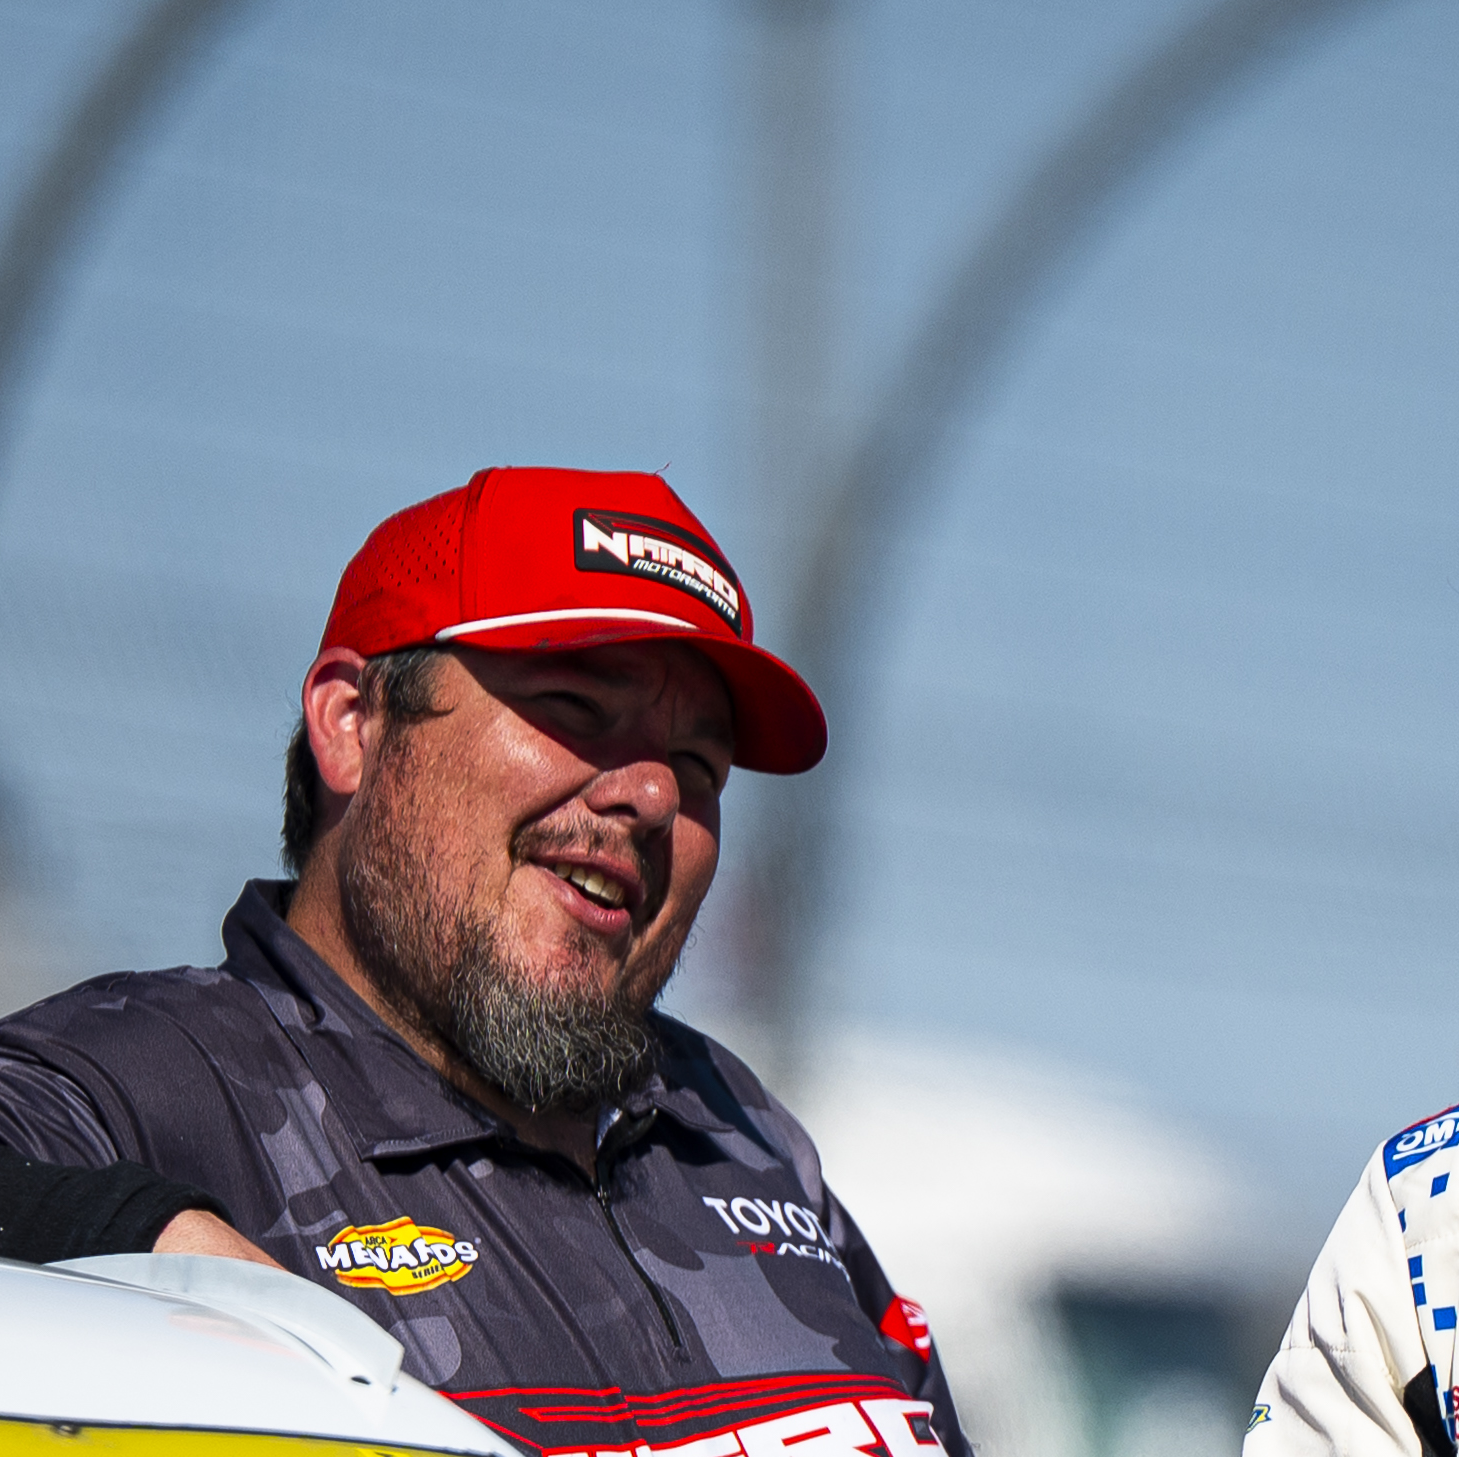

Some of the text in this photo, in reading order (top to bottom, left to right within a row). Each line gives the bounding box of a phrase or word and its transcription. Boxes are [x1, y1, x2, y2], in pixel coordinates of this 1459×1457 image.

[583, 518, 739, 612] NITRO
[633, 558, 737, 620] MOTORSPORTS
[702, 1196, 834, 1248] TOYOT
